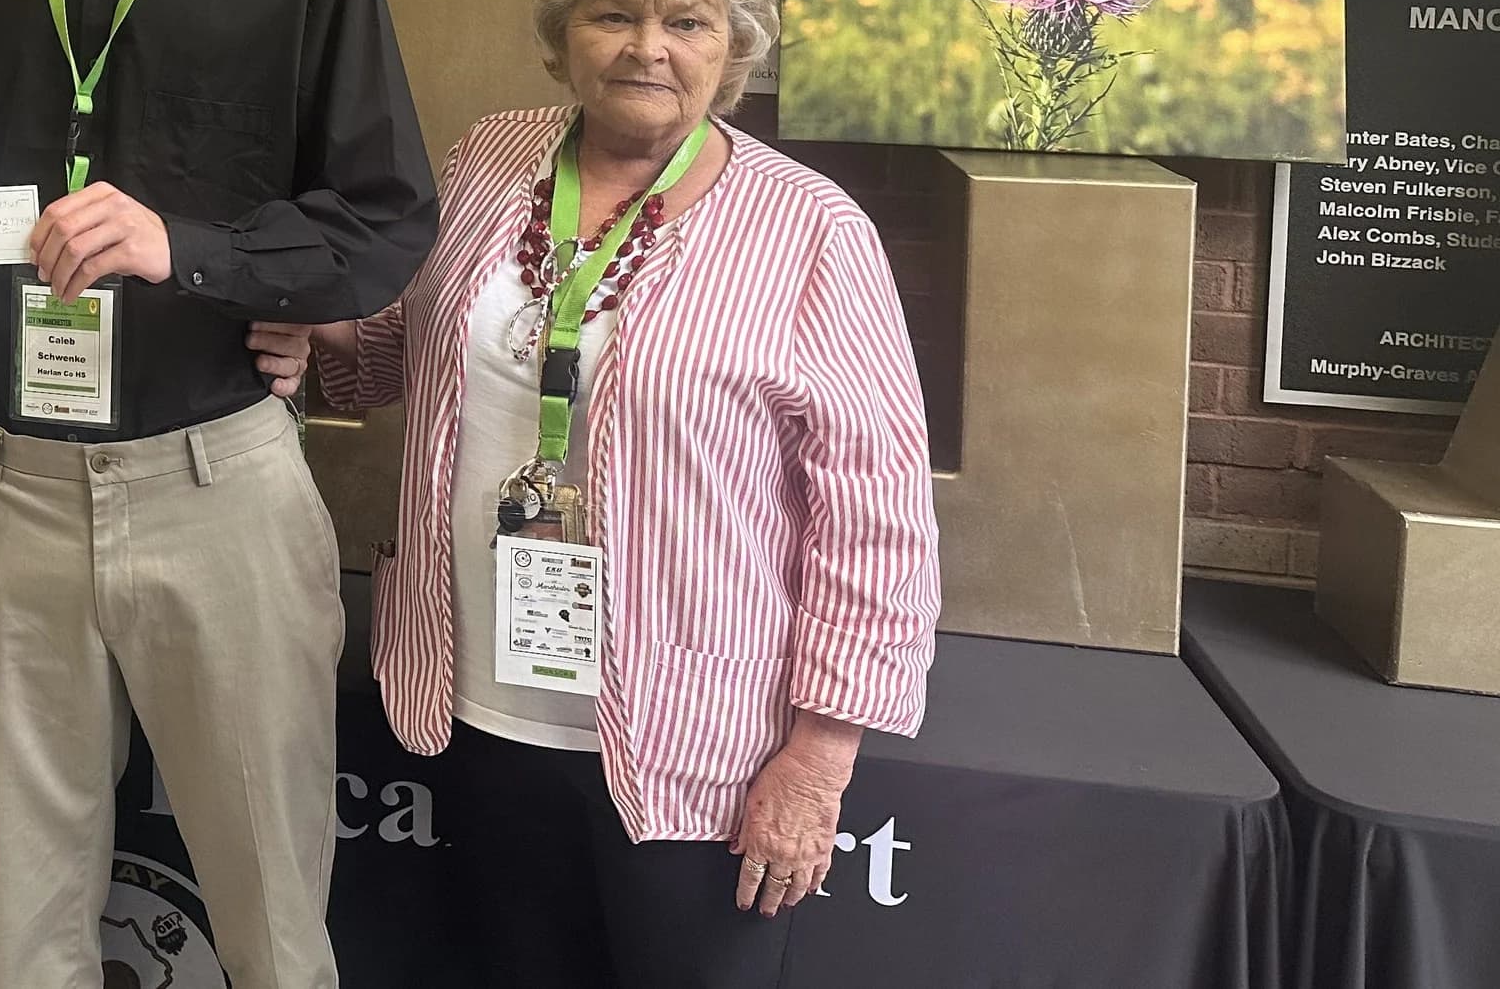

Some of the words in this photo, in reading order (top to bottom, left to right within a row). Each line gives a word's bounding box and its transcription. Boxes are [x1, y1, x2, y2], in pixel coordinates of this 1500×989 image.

[1395, 132, 1456, 151] Bates,
[1374, 155, 1441, 176] Abney,
[1444, 159, 1488, 175] Vice
[1320, 177, 1387, 195] Steven
[1393, 181, 1497, 203] Fulkerson,
[1319, 201, 1401, 220] Malcolm
[1407, 205, 1480, 225] Frisbie,
[1317, 226, 1361, 242] Alex
[1366, 228, 1442, 249] Combs,
[1316, 250, 1365, 267] John
[1371, 253, 1447, 271] Bizzack
[48, 335, 75, 346] Caleb
[37, 352, 86, 364] Schwenke
[37, 368, 62, 376] Harlan
[63, 370, 73, 378] Co
[1310, 359, 1460, 384] Murphy-Graves
